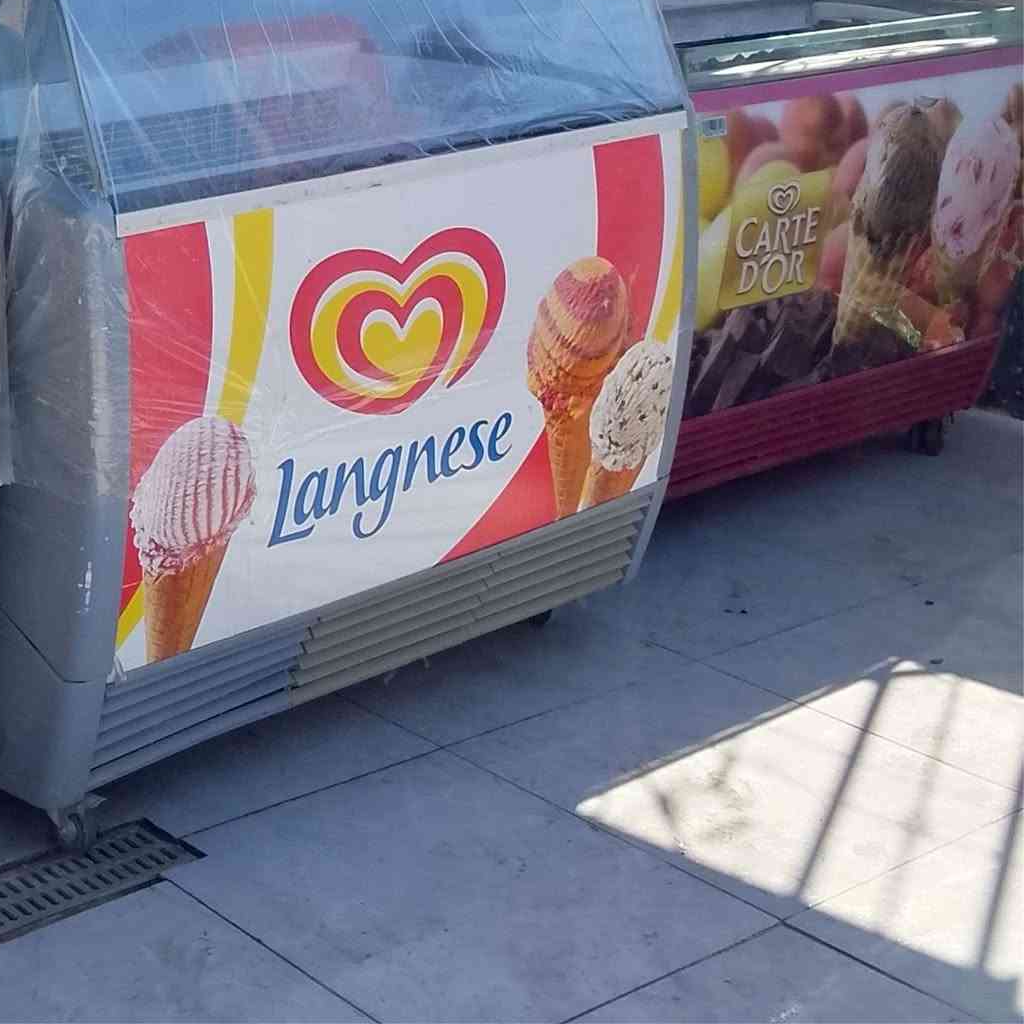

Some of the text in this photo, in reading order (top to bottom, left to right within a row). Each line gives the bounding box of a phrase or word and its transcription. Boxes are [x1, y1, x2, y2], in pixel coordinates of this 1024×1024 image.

[736, 207, 820, 259] CARTE
[736, 249, 805, 295] D'OR
[267, 412, 513, 548] Langnese
